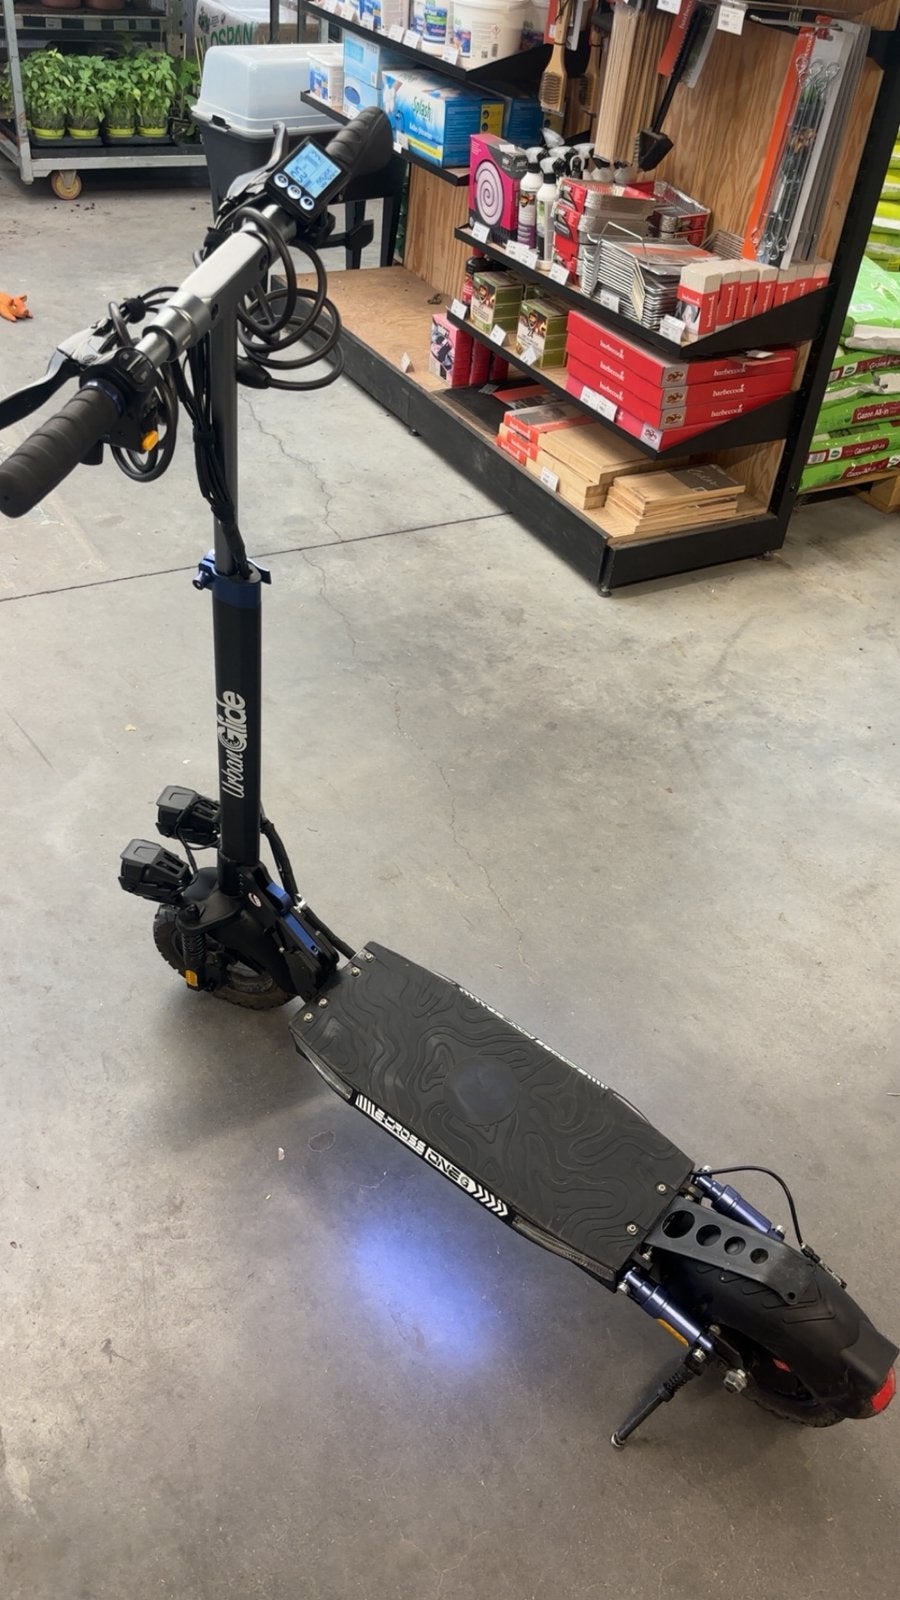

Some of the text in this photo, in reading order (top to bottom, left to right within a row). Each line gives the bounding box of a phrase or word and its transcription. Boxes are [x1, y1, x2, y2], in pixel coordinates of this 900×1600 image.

[713, 364, 746, 377] barbecook
[712, 383, 745, 397] barbecook
[710, 404, 744, 417] barbecook
[374, 1107, 427, 1154] E-CROSS
